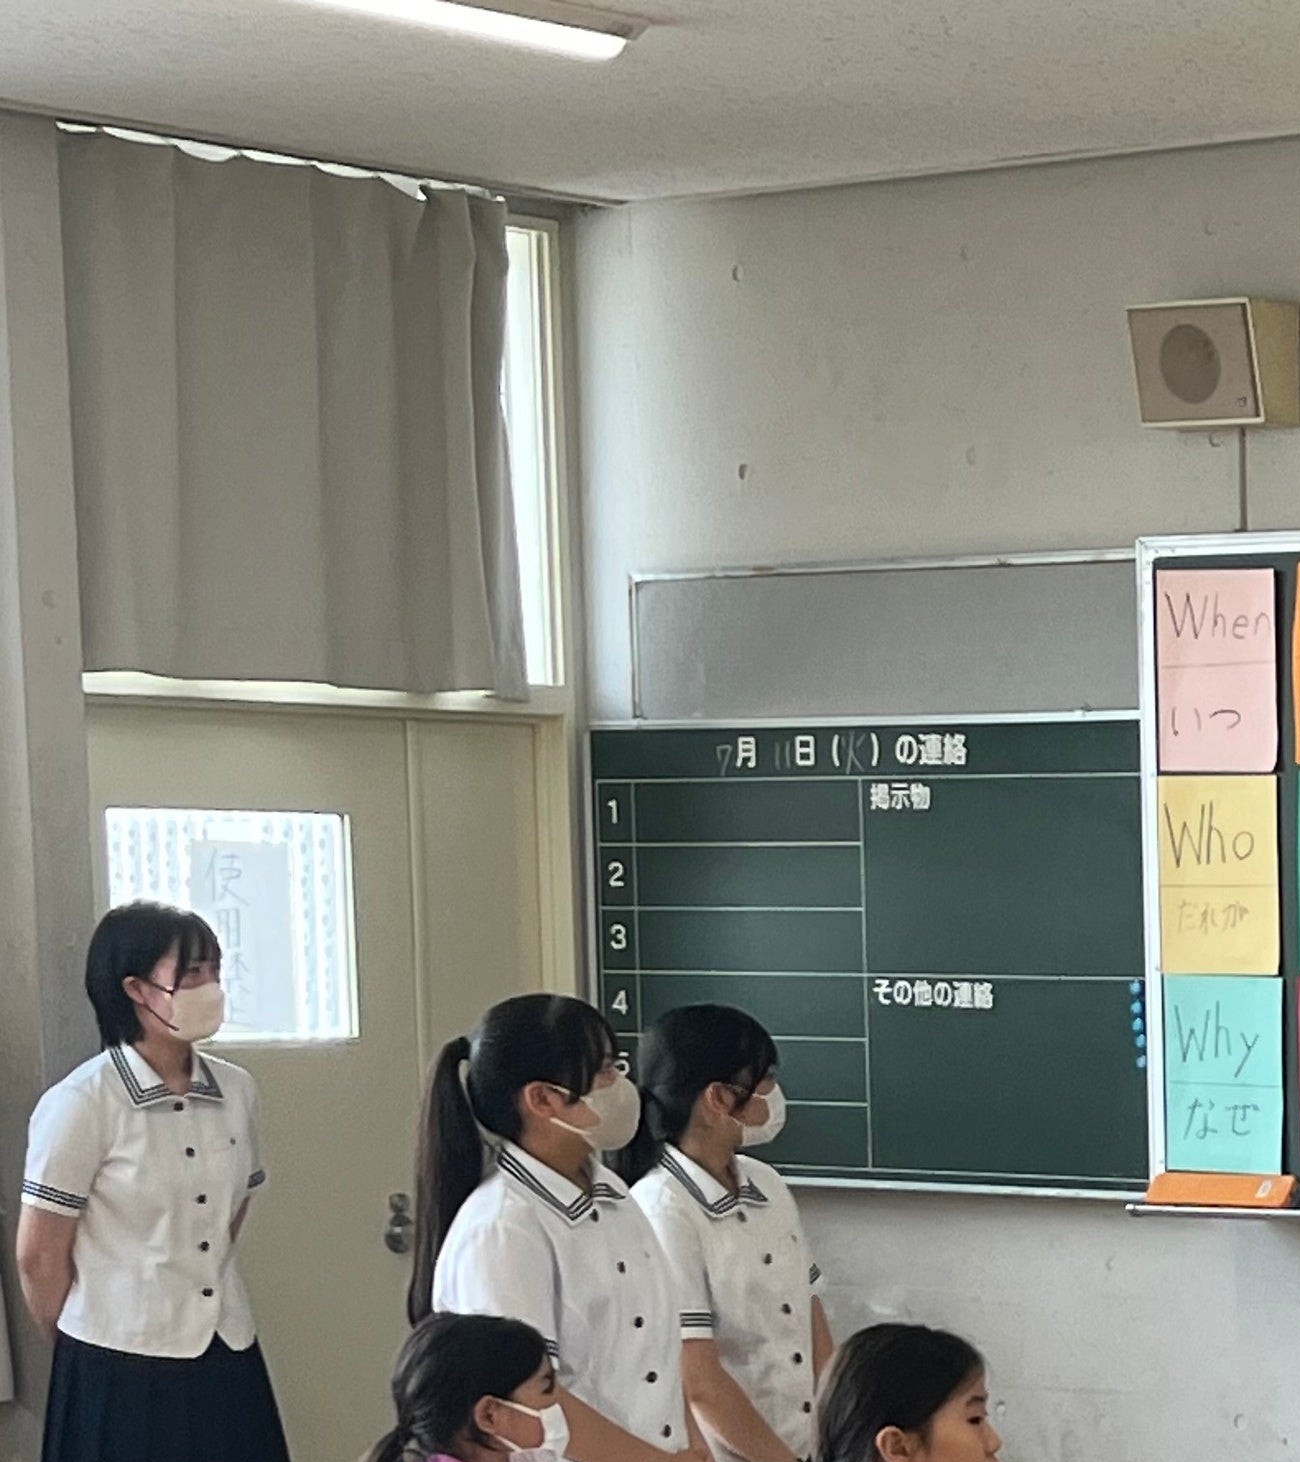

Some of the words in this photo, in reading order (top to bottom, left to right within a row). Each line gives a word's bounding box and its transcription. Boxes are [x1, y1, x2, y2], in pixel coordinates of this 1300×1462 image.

[1163, 590, 1272, 641] When
[1170, 705, 1243, 738] いつ
[870, 783, 931, 811] 掲示物
[607, 802, 618, 823] 1
[1164, 802, 1256, 868] Who
[609, 862, 624, 887] 2
[610, 924, 627, 949] 3
[611, 989, 628, 1014] 4
[872, 979, 994, 1009] その他の連絡
[1174, 1001, 1260, 1078] Why
[1184, 1097, 1260, 1140] なぜ
